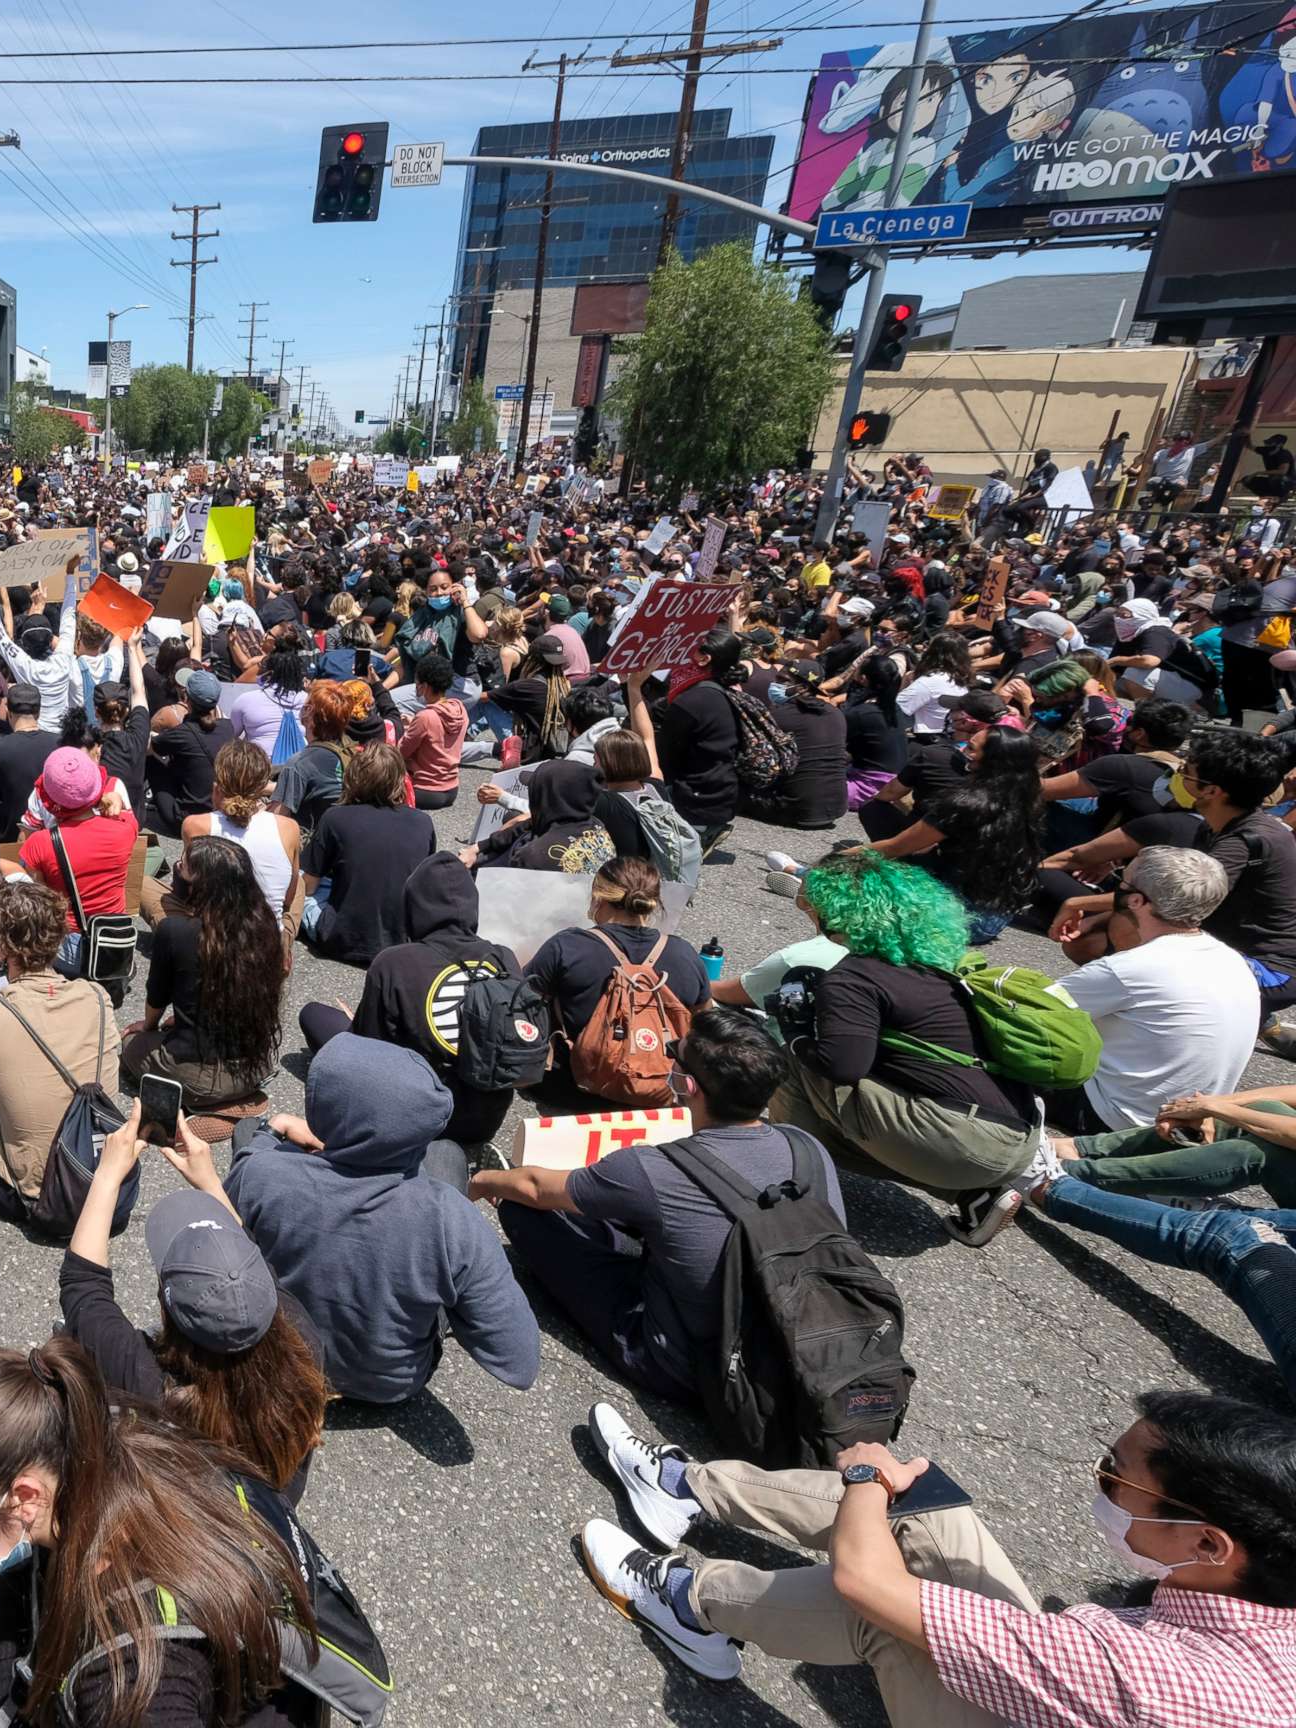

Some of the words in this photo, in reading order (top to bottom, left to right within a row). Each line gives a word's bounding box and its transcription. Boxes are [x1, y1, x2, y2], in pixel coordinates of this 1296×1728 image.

[1012, 141, 1080, 162] WE'VE
[1084, 135, 1137, 156] GOT
[1140, 131, 1183, 150] THE
[1187, 123, 1269, 147] MAGIC
[399, 148, 415, 161] DO
[418, 147, 437, 159] NOT
[560, 153, 589, 165] Spine
[601, 147, 671, 162] Orthopedics
[401, 161, 433, 174] BLOCK
[393, 174, 439, 184] INTERSECTION
[830, 219, 854, 238] La
[862, 215, 955, 236] Cienega
[1053, 206, 1165, 227] OUTFRON
[644, 584, 745, 619] JUSTICE
[606, 630, 710, 671] GEORGE
